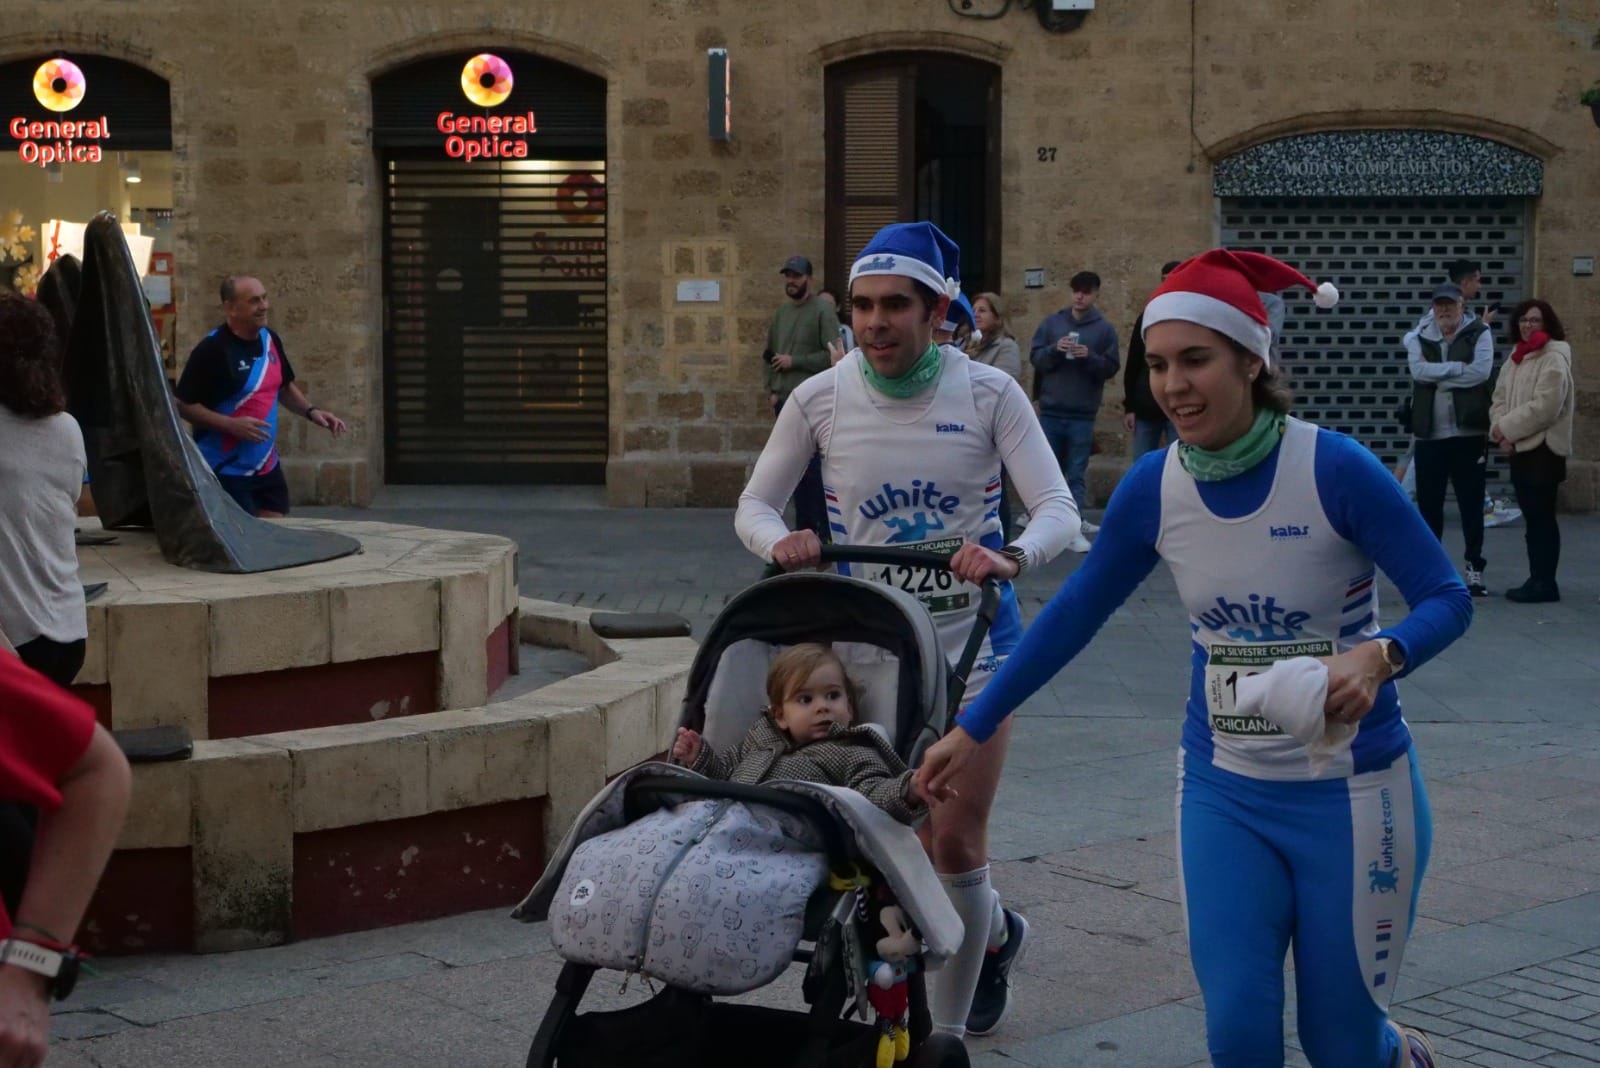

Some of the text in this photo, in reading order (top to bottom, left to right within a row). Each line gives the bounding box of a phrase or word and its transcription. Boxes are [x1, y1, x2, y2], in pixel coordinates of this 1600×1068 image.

[9, 116, 110, 138] General
[436, 111, 537, 133] General
[19, 140, 103, 168] Optica
[445, 135, 528, 162] Optica
[1037, 147, 1057, 162] 27
[1283, 160, 1329, 175] MODA
[1345, 160, 1471, 175] COMPLEMENTOS
[936, 423, 965, 432] kalas
[859, 479, 960, 521] white
[1270, 525, 1309, 537] kalas
[916, 539, 962, 551] CHICLANERA
[880, 566, 951, 593] 1226
[1199, 593, 1311, 631] white
[1227, 646, 1267, 656] SILVESTRE
[1270, 643, 1329, 656] CHICLANERA
[1215, 717, 1278, 732] CHICLANA
